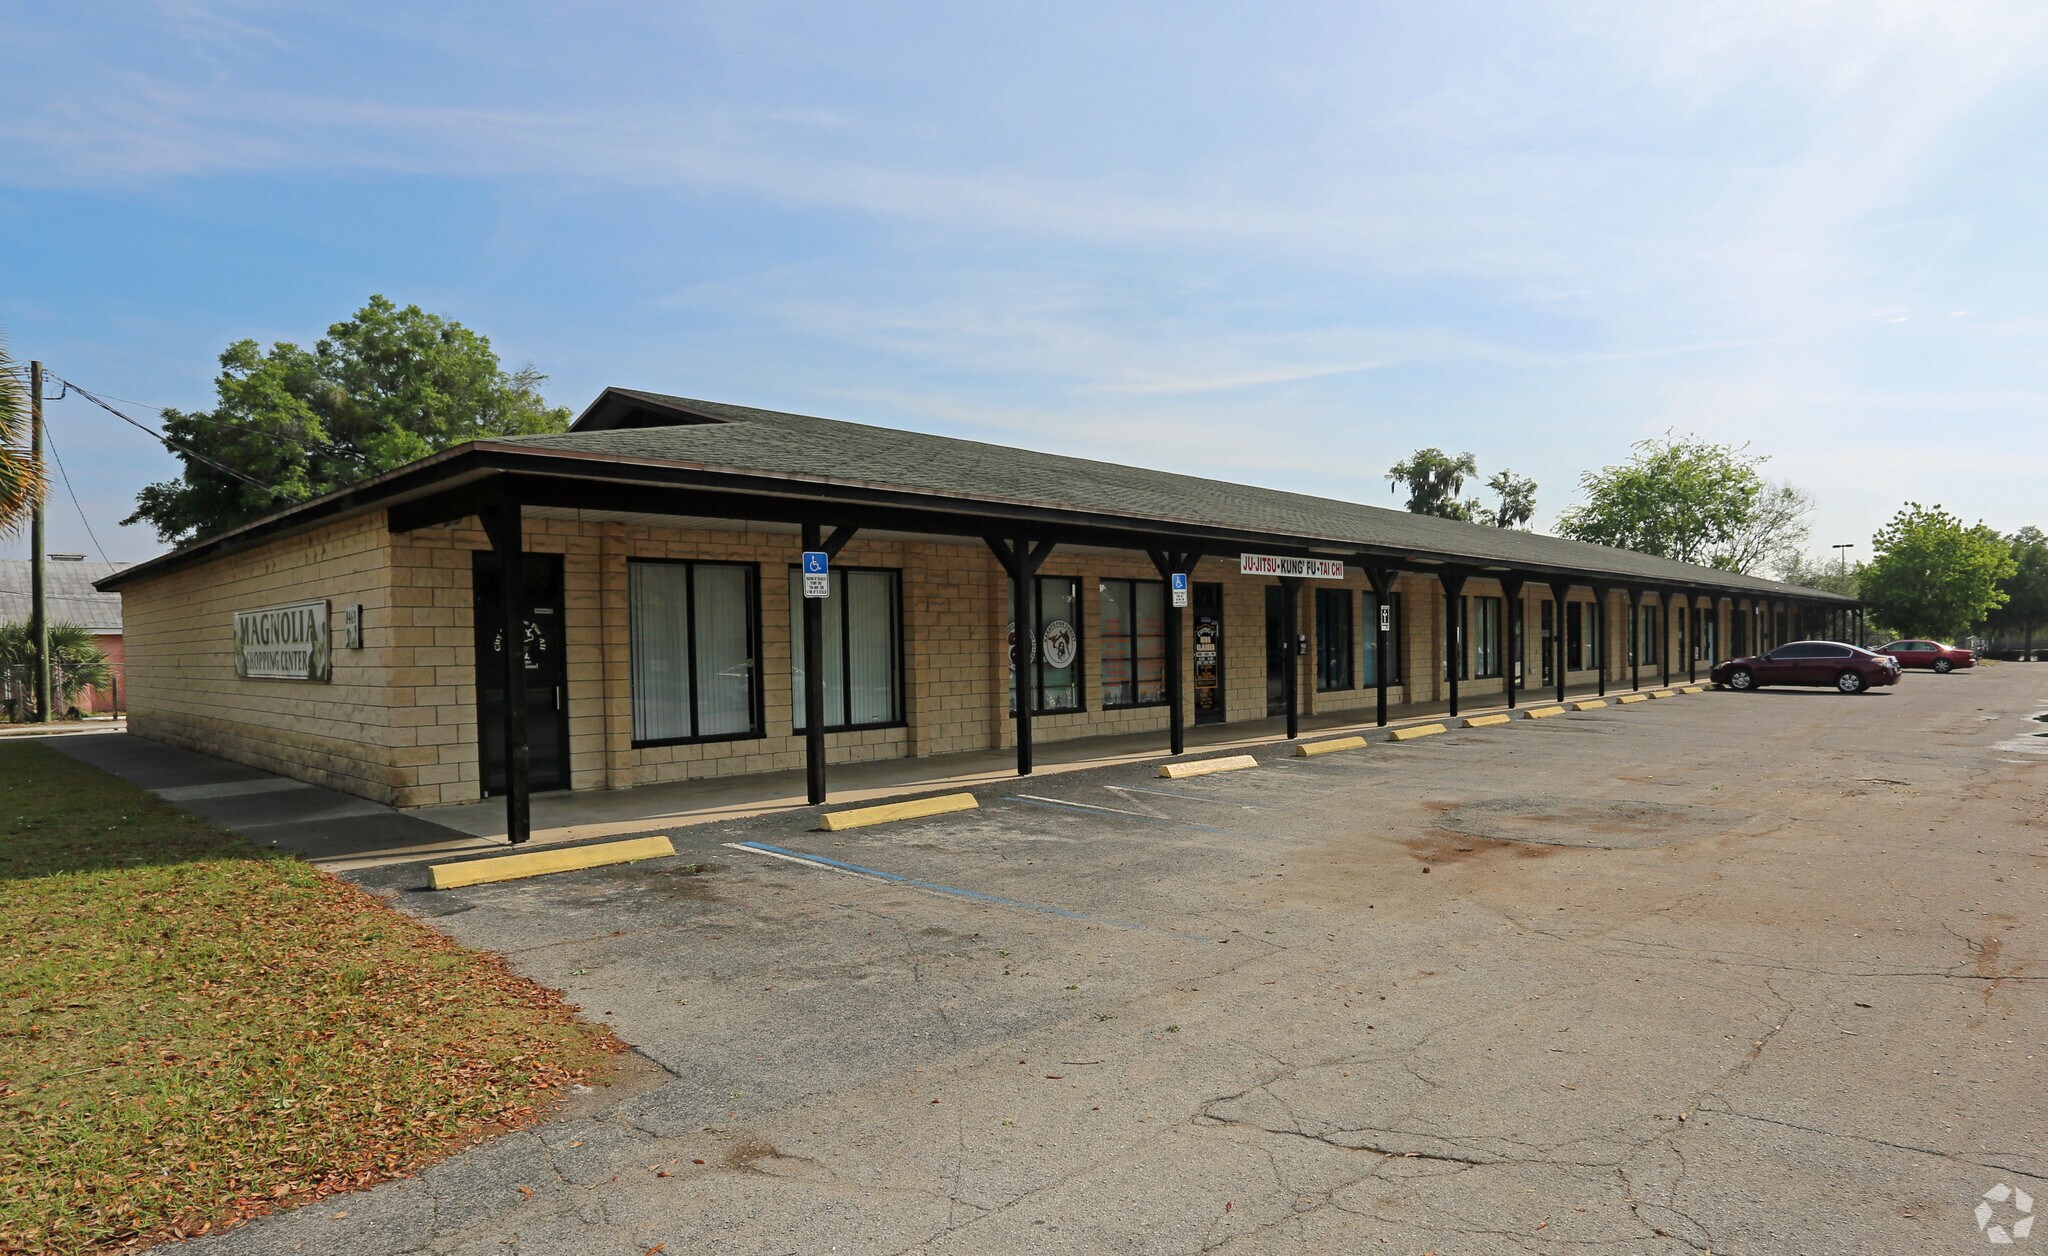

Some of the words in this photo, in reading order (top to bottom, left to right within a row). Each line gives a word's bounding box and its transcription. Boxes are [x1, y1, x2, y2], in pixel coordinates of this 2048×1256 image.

[1306, 560, 1316, 575] FU
[1319, 561, 1330, 576] TAI
[1331, 562, 1343, 577] CHI
[240, 609, 319, 646] MAGNOLIA
[493, 633, 503, 652] City
[530, 622, 542, 635] For
[539, 637, 547, 651] All
[246, 650, 280, 671] SHOPPING
[281, 650, 309, 672] CENTER
